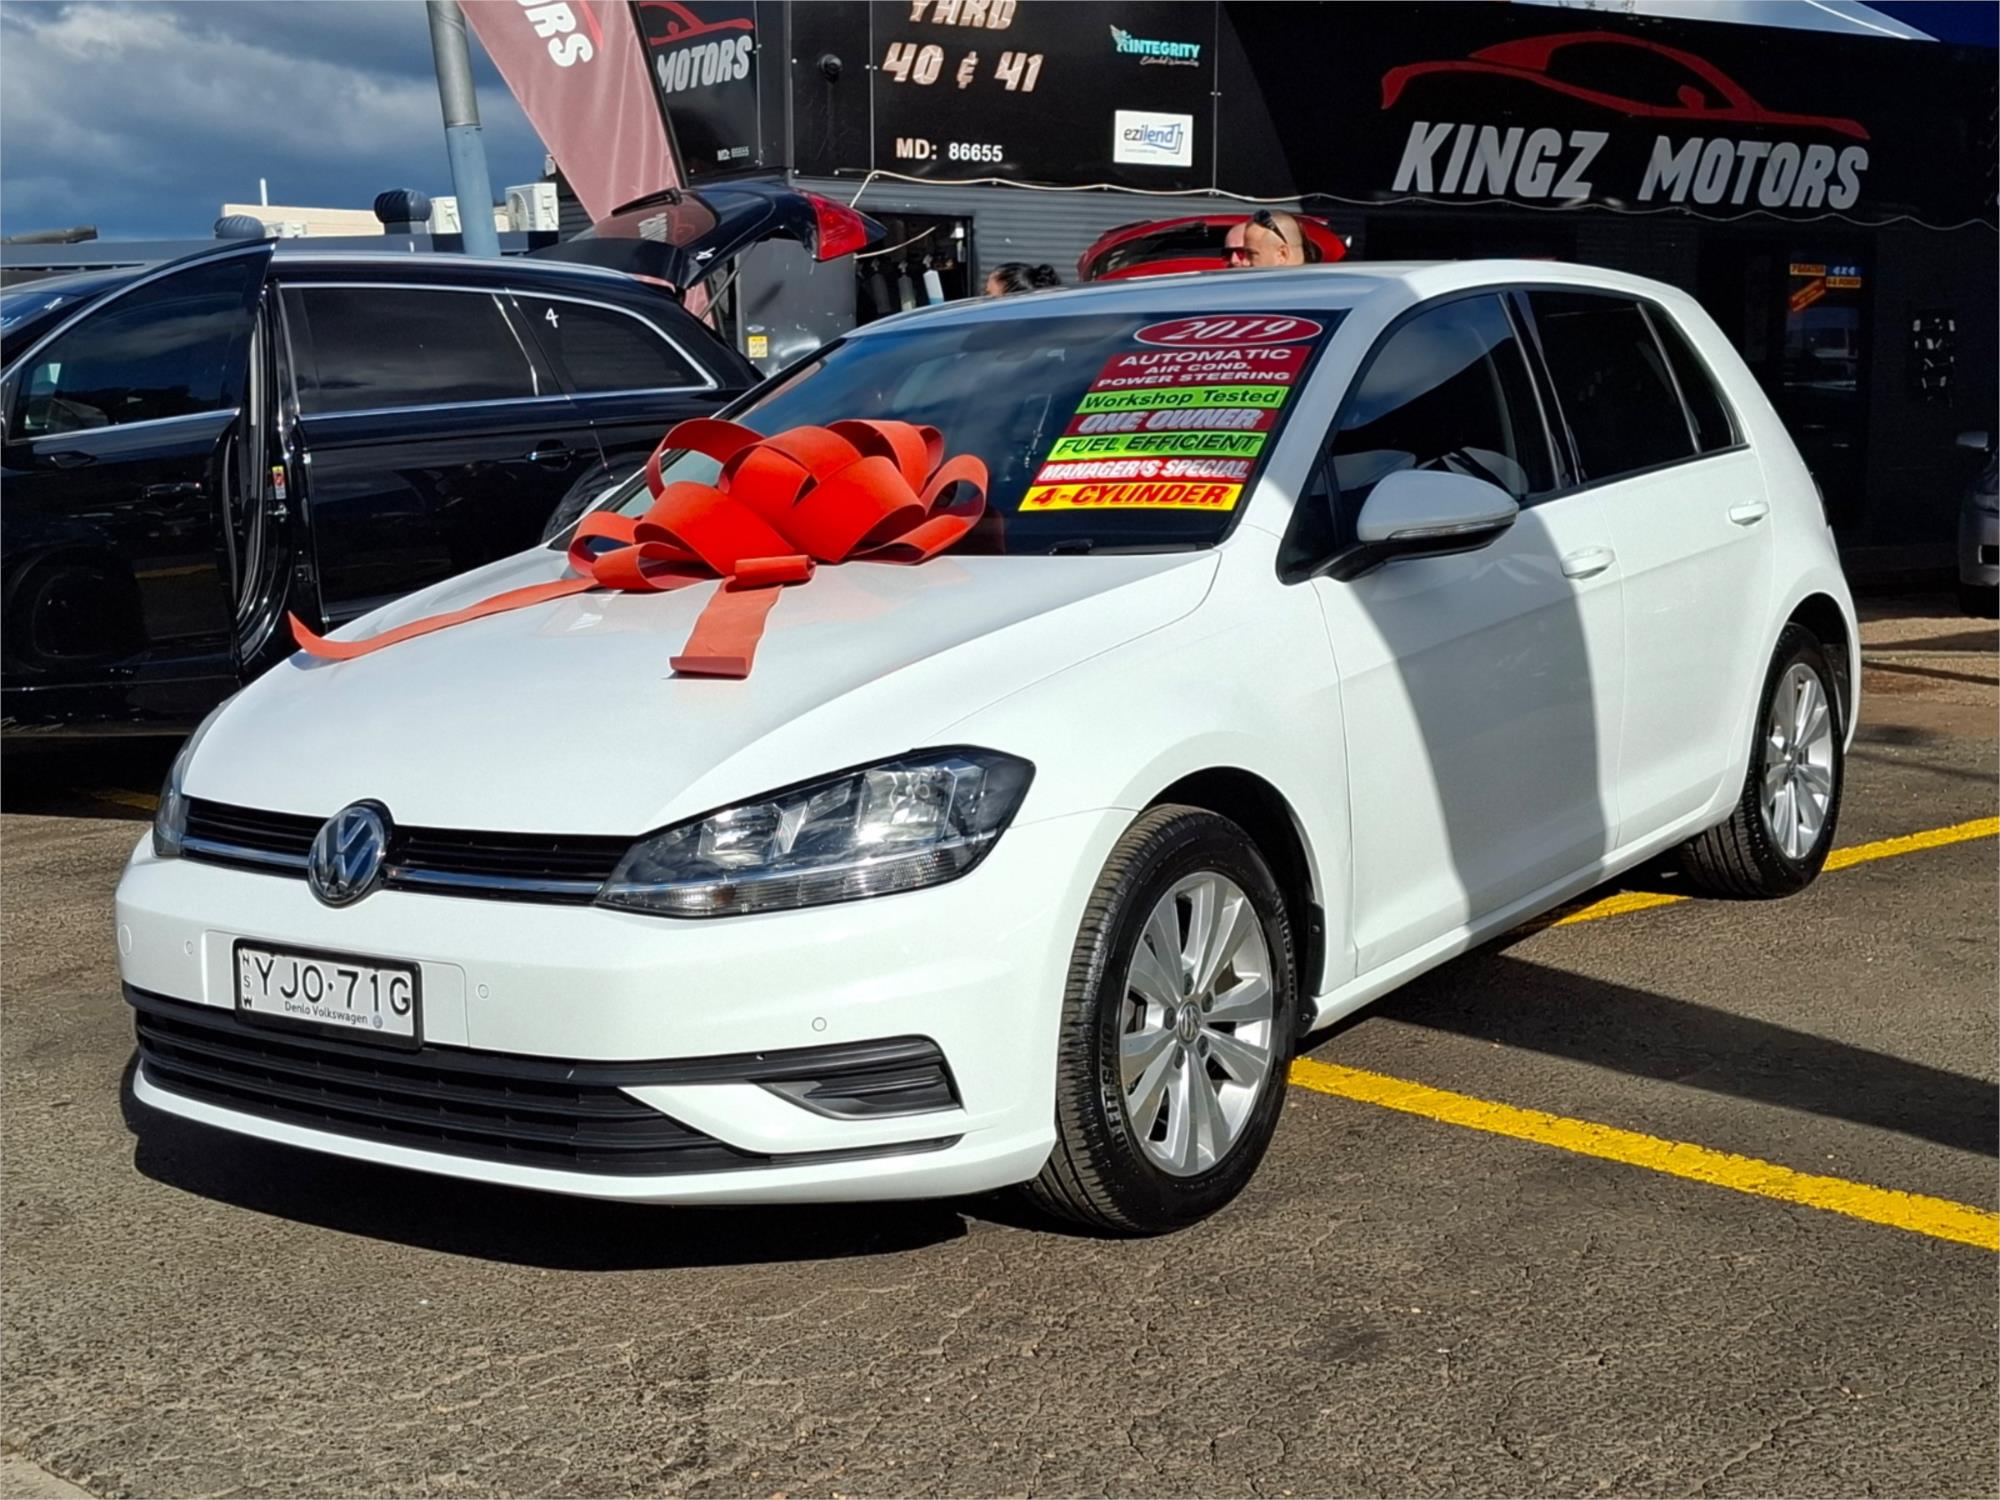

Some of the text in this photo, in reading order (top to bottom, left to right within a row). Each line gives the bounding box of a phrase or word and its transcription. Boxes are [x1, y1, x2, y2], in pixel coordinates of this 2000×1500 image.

[1129, 39, 1200, 58] INTEGRITY
[657, 35, 753, 93] MOTORS
[882, 42, 944, 85] 40
[994, 51, 1044, 92] 41
[1123, 124, 1176, 143] ezilend
[896, 137, 1003, 162] MD: 86655
[1391, 121, 1869, 209] KINGZ MOTORS
[545, 307, 559, 328] 4
[1160, 320, 1297, 340] 2019
[1118, 349, 1292, 367] AUTOMATIC
[1145, 362, 1253, 374] AIR COND.
[1097, 371, 1290, 387] POWER STEERING
[1085, 389, 1279, 408] Workshop Tested
[1078, 408, 1264, 433] ONE OWNER
[1056, 434, 1265, 455] FUEL EFFICIENT
[1038, 459, 1250, 481] MANAGER'S SPECIAL
[1031, 484, 1231, 506] 4-CYLINDER
[284, 1001, 368, 1025] Denlo Volkswagen
